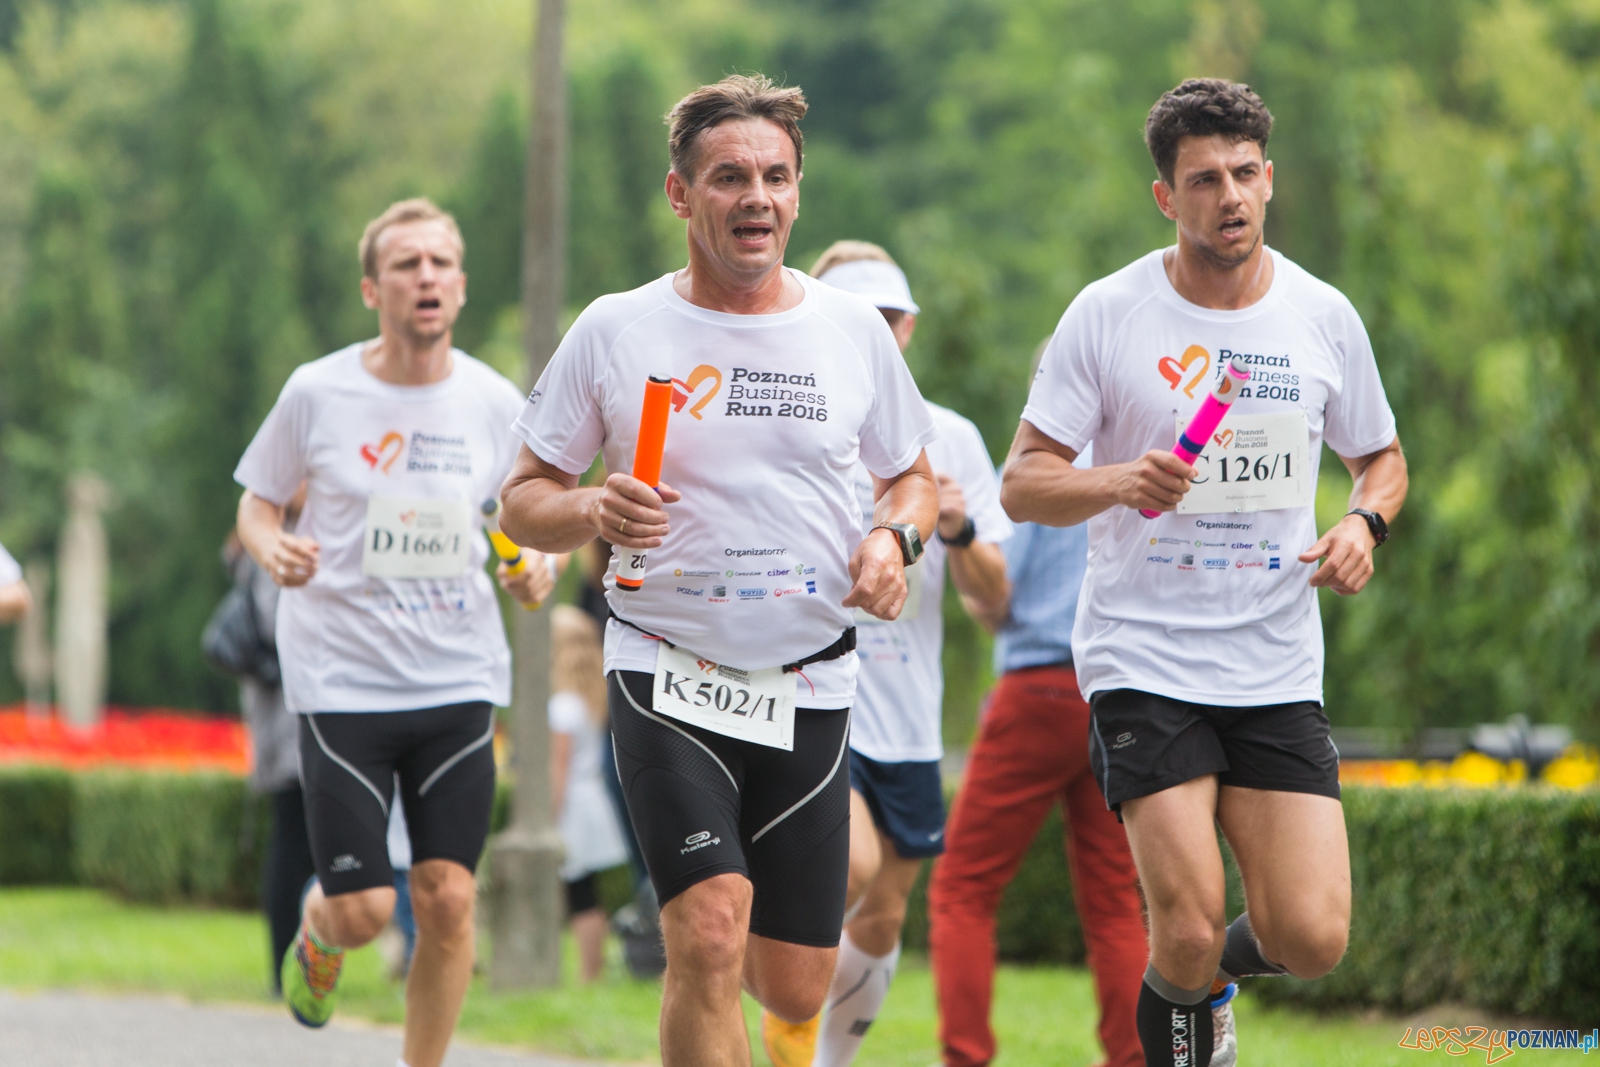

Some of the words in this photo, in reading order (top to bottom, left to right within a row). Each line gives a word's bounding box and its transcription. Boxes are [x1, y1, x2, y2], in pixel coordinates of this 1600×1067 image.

[731, 367, 817, 388] Poznań
[728, 385, 827, 406] Business
[1256, 385, 1301, 402] 2016
[725, 402, 772, 416] Run
[778, 403, 828, 422] 2016
[1196, 519, 1252, 531] Organizatorzy:
[725, 548, 787, 558] Organizatorzy:
[1231, 542, 1254, 550] ciber
[767, 568, 791, 577] ciber
